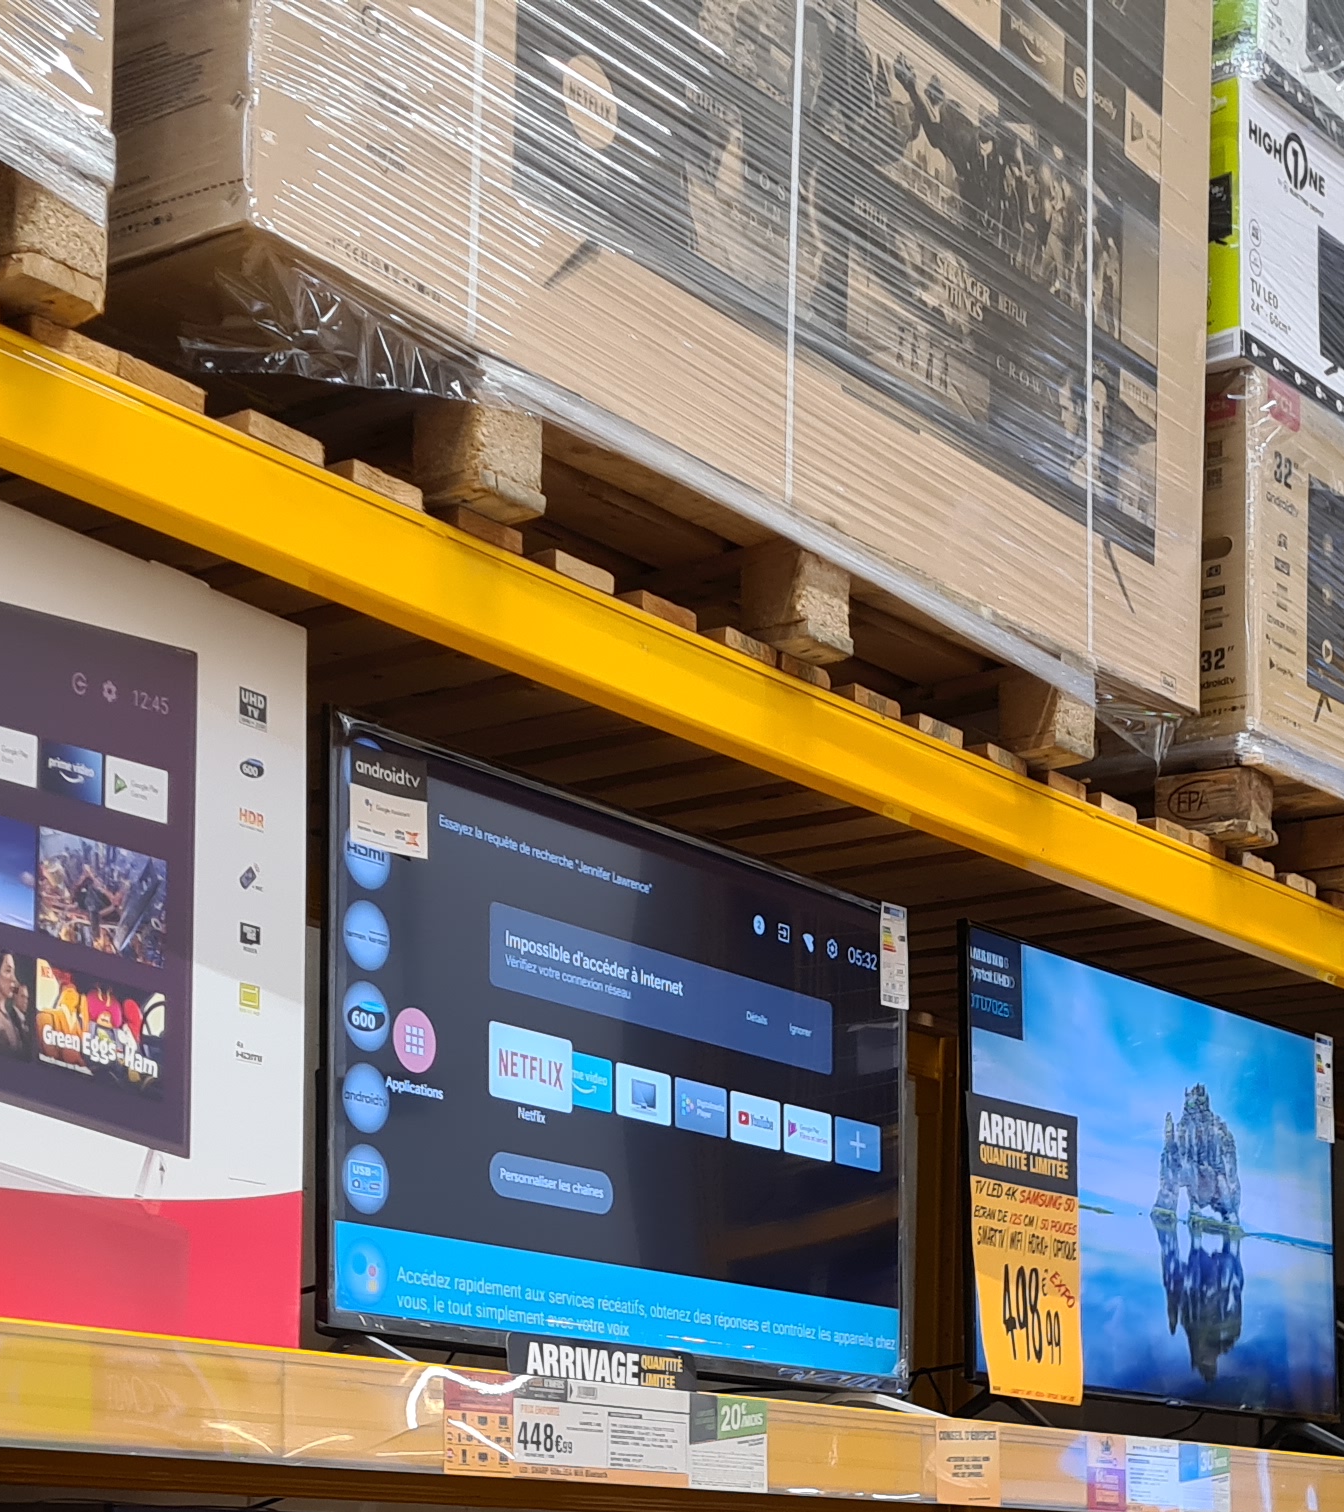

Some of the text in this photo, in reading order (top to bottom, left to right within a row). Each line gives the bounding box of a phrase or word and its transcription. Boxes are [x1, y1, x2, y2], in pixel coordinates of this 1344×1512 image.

[1248, 119, 1282, 164] HIGH
[935, 254, 991, 307] STRANGER
[1250, 277, 1278, 309] TV LED
[1274, 450, 1298, 490] 32"
[1201, 646, 1234, 673] 32"
[132, 690, 170, 715] 12:45
[356, 759, 420, 788] androidtv
[239, 808, 264, 829] HDR
[439, 813, 573, 870] Essayez requête recherche
[505, 930, 683, 997] Impossible d'accéder Internet
[505, 954, 603, 992] Vérifiez connexion
[848, 946, 877, 971] 05:32
[351, 1011, 375, 1030] 600
[789, 1022, 812, 1038] Ignorer
[42, 1025, 82, 1053] Green
[498, 1048, 563, 1091] NETFLIX
[344, 1090, 388, 1107] androidtv
[385, 1076, 443, 1100] Applications
[517, 1106, 546, 1124] Netflix
[979, 1111, 1068, 1161] ARRIVAGE
[500, 1168, 603, 1199] Personnaliser chaînes
[986, 1182, 1063, 1210] LED 4K SAMSUNG
[974, 1205, 996, 1221] ECRAN
[1052, 1237, 1077, 1261] OPTIQUE
[396, 1264, 815, 1342] Accédez rapidement services obtenez réponses contrôlez
[1050, 1271, 1075, 1309] EXPO
[475, 1301, 544, 1329] simplement
[1003, 1263, 1043, 1363] 498
[1046, 1309, 1061, 1365] 99
[526, 1341, 640, 1386] ARRIVAGE
[641, 1354, 684, 1373] QUANTITÉ
[641, 1371, 676, 1390] LIMITÉE
[517, 1421, 573, 1454] 448€99
